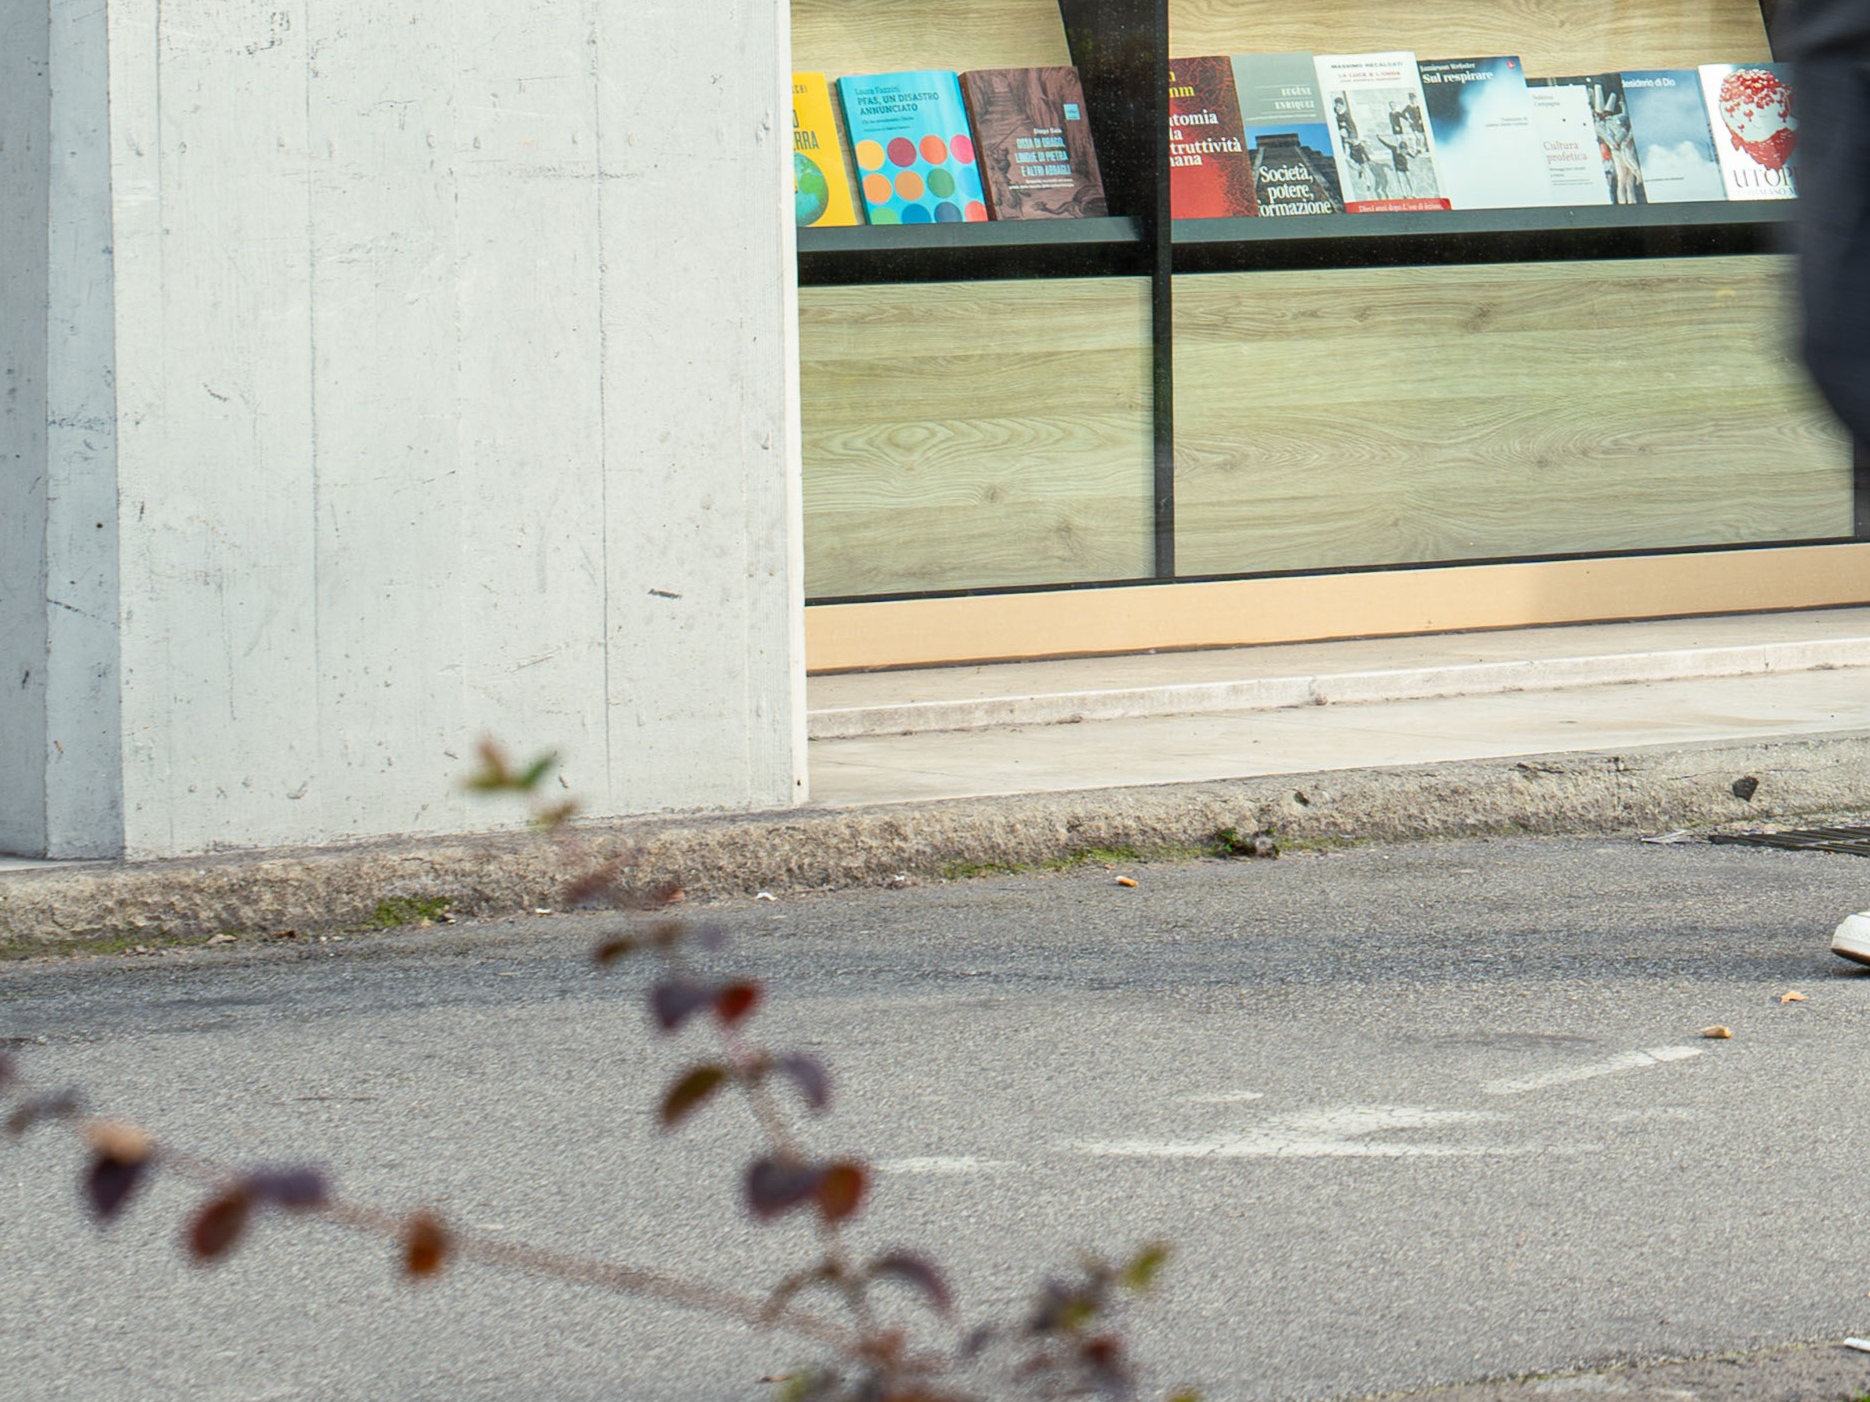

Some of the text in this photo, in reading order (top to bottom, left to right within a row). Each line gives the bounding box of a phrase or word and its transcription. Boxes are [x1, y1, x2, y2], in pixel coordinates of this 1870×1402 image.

[1420, 63, 1449, 72] Jamieson
[1422, 70, 1494, 84] Sul respirare
[1655, 78, 1676, 88] di Dio
[857, 91, 940, 107] PFAS, UN DISASTRO
[859, 103, 918, 116] ANNUNCIATO
[1171, 137, 1243, 156] truttività
[1543, 140, 1579, 151] Cultura
[1546, 152, 1588, 164] profetica
[1259, 162, 1314, 184] Società,
[1267, 181, 1315, 205] potere,
